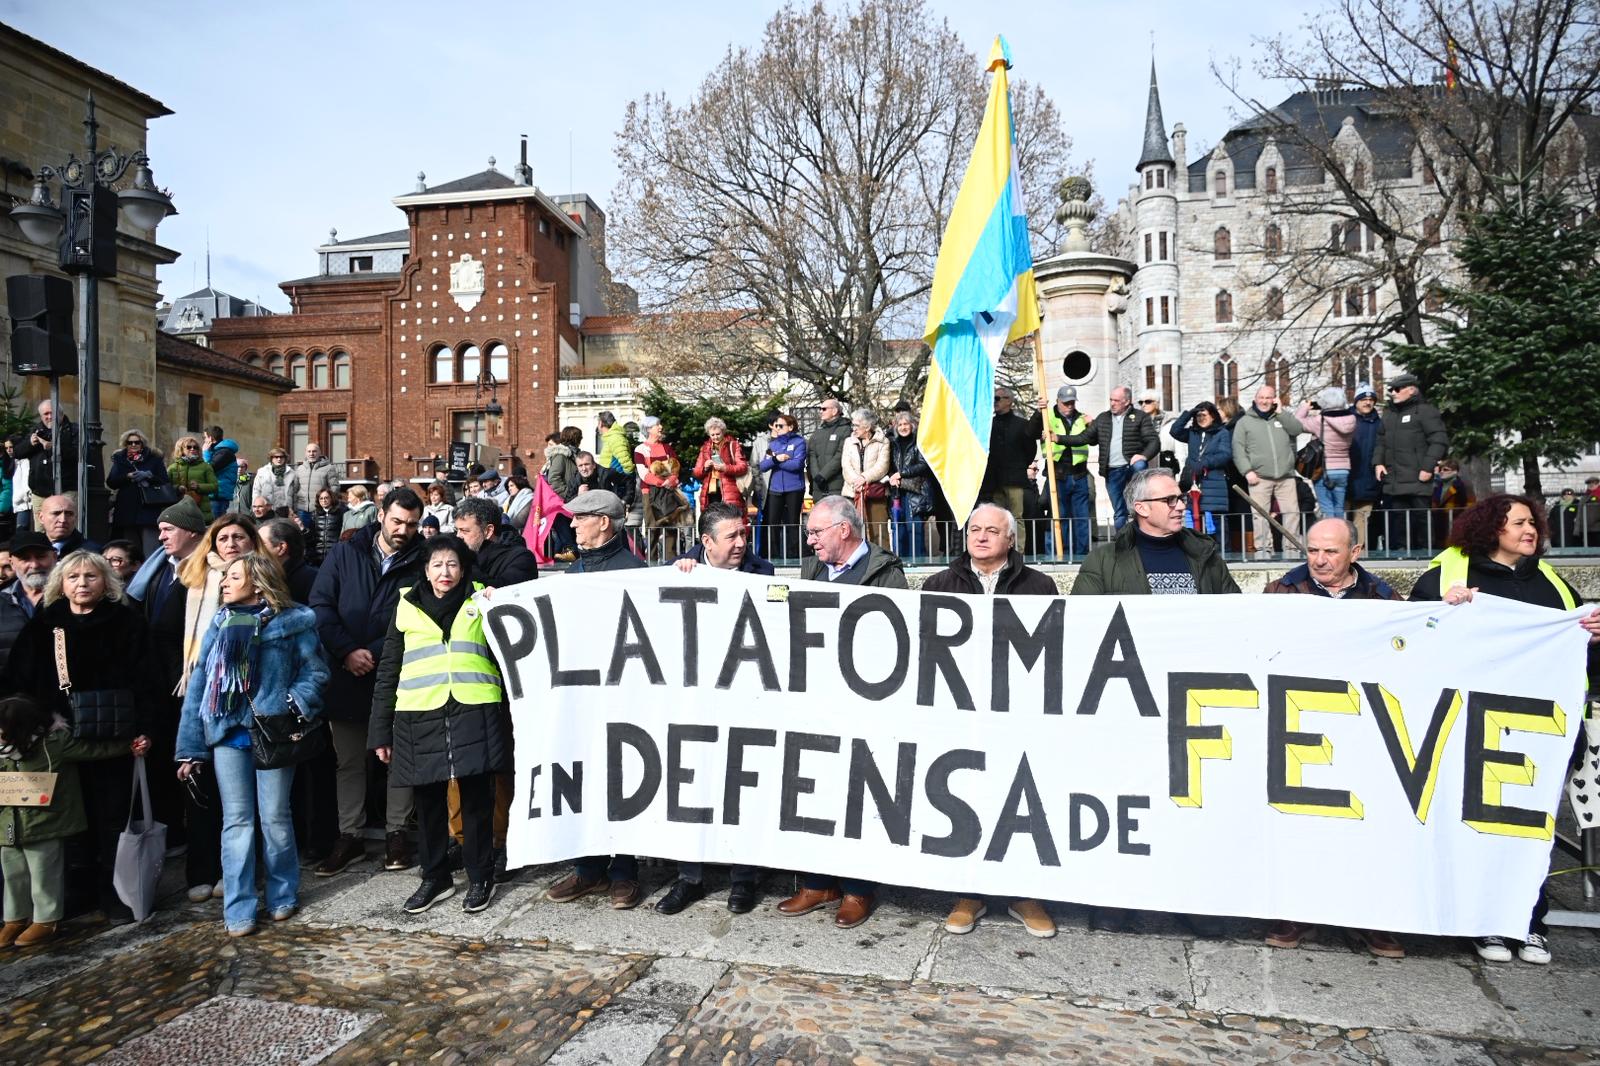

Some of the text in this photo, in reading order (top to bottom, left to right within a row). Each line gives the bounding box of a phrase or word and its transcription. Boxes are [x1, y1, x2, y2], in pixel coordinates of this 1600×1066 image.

[485, 586, 1160, 718] PLATAFORMA
[528, 672, 1566, 867] EN DEFENSA DE FEVE
